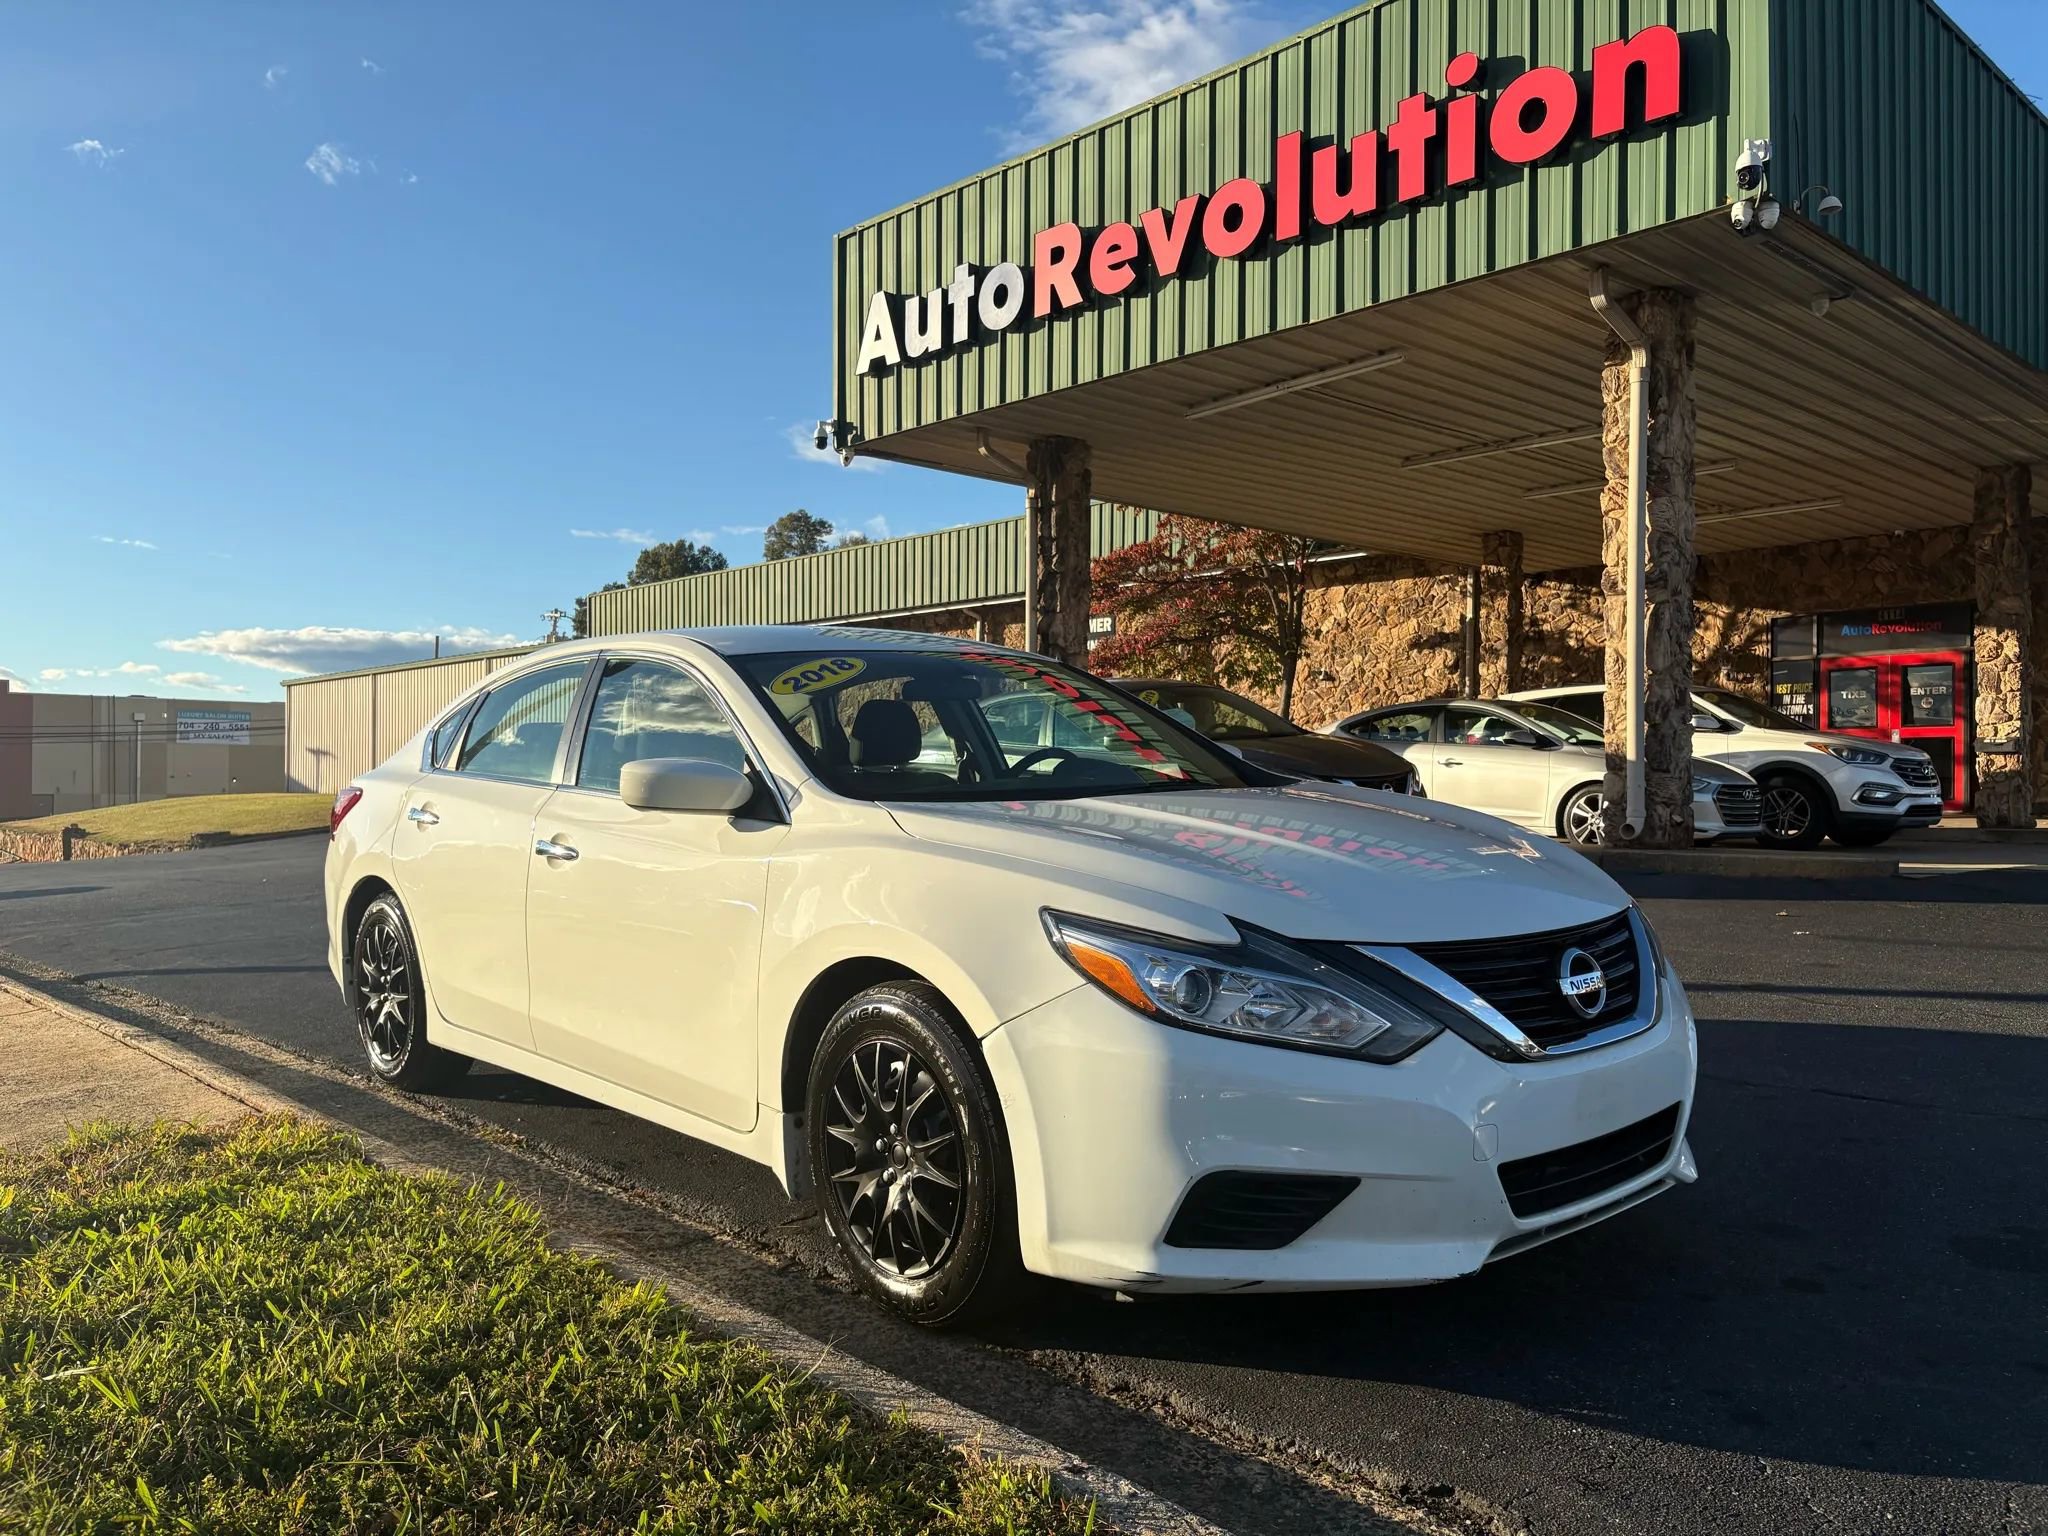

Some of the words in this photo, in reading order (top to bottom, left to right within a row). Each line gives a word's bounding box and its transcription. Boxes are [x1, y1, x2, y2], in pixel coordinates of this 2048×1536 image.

[855, 24, 1682, 377] AutoRevolution
[1088, 617, 1112, 633] MER
[782, 658, 858, 692] 2018
[1793, 682, 1814, 694] PRICE
[1910, 686, 1947, 696] ENTER
[1782, 694, 1791, 705] IN
[1792, 693, 1806, 705] THE
[1569, 974, 1605, 991] NISSA
